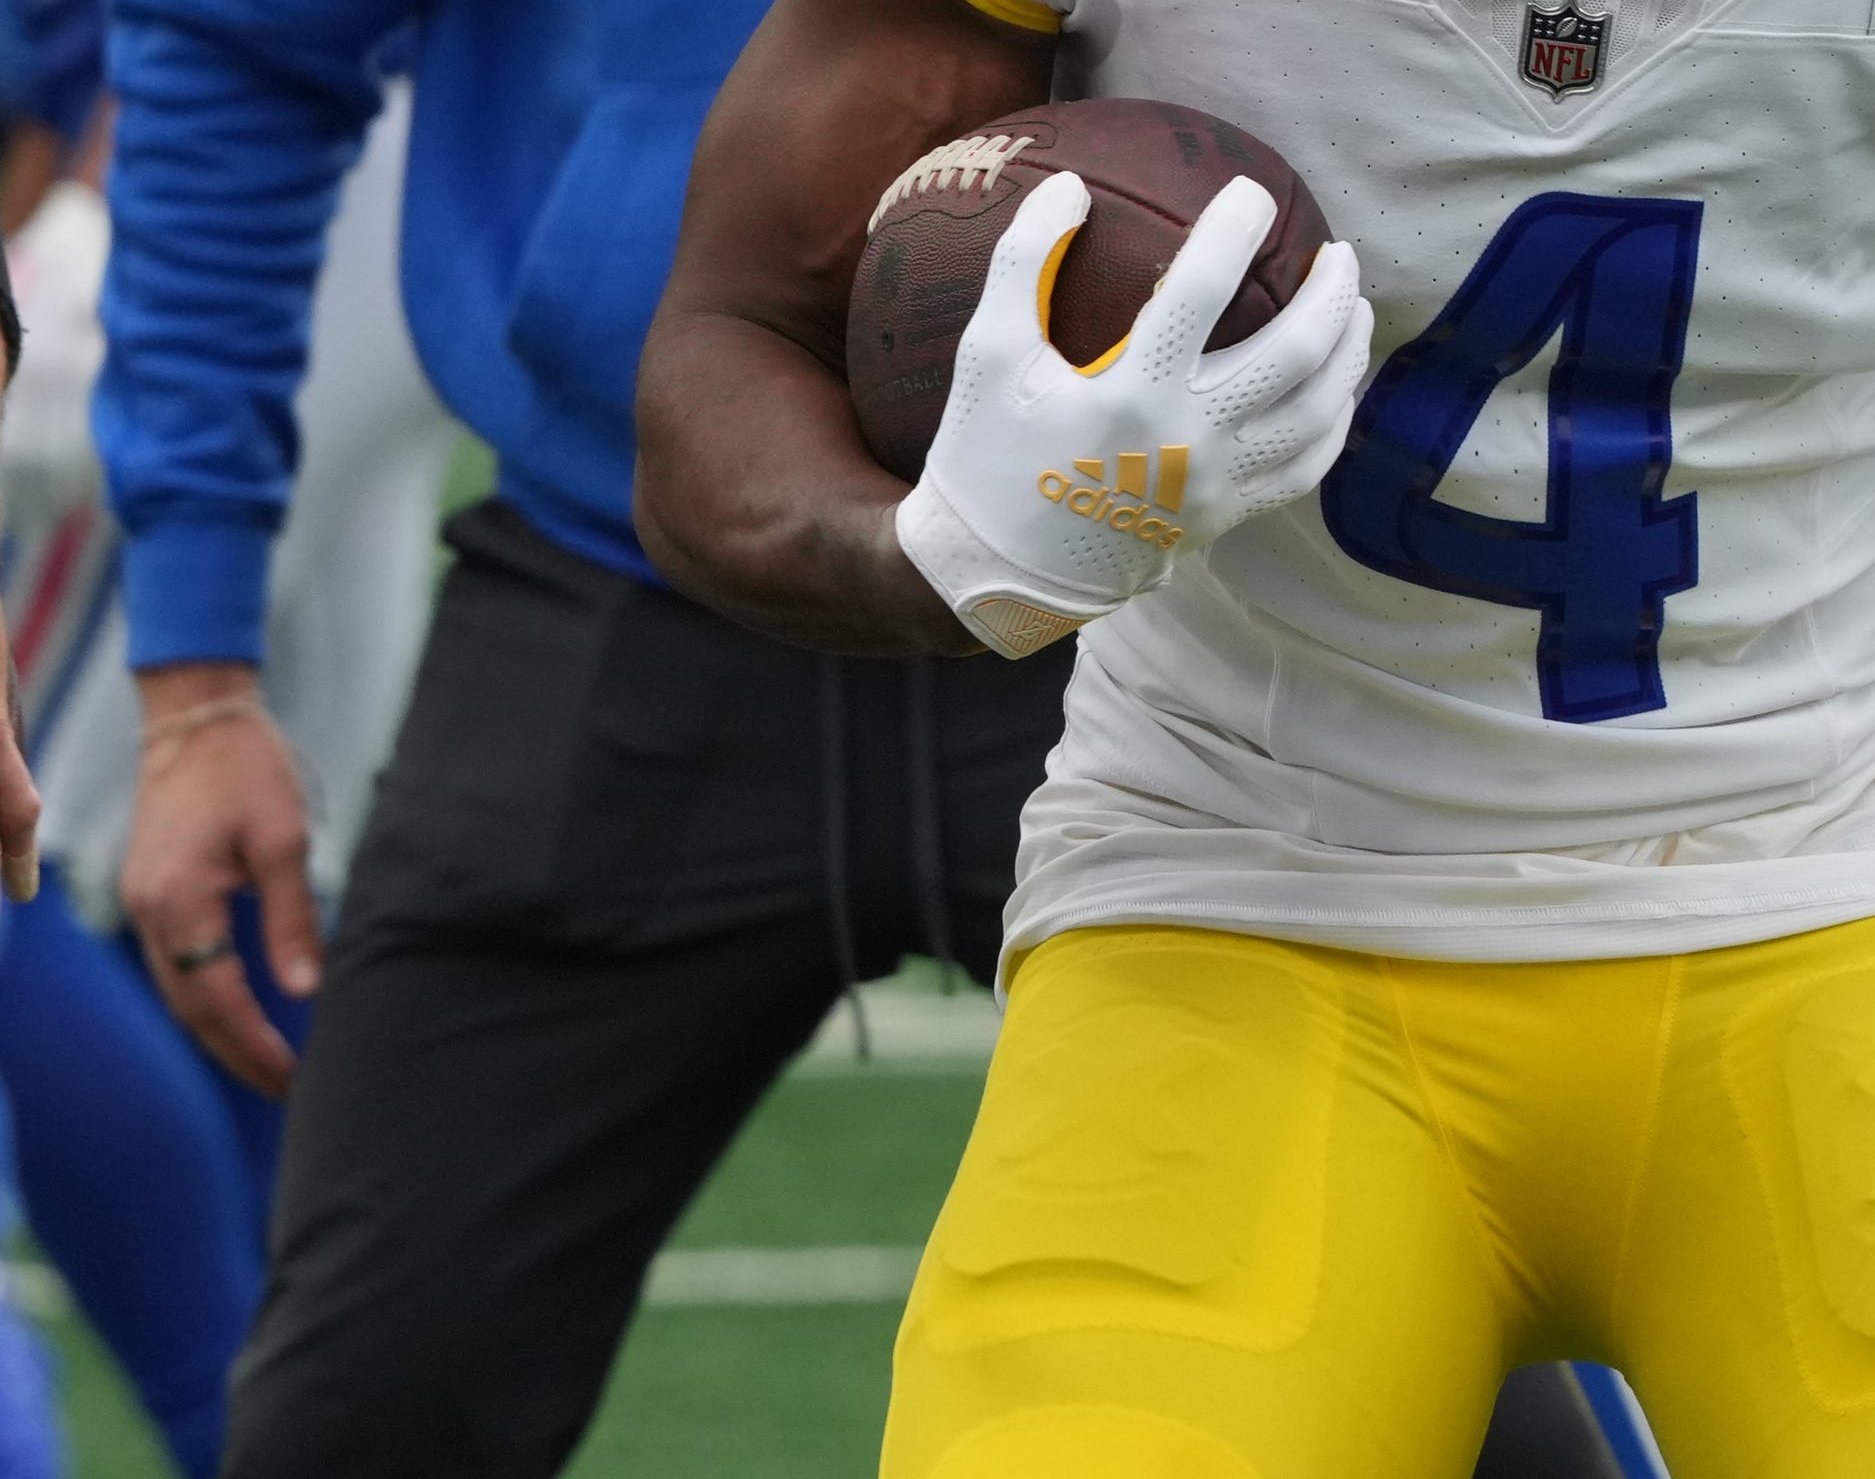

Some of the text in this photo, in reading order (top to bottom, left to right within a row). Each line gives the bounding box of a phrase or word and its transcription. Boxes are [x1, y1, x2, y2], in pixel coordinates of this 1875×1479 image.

[1531, 41, 1593, 84] NFL
[1321, 191, 1705, 722] 4
[1037, 468, 1185, 550] adidas
